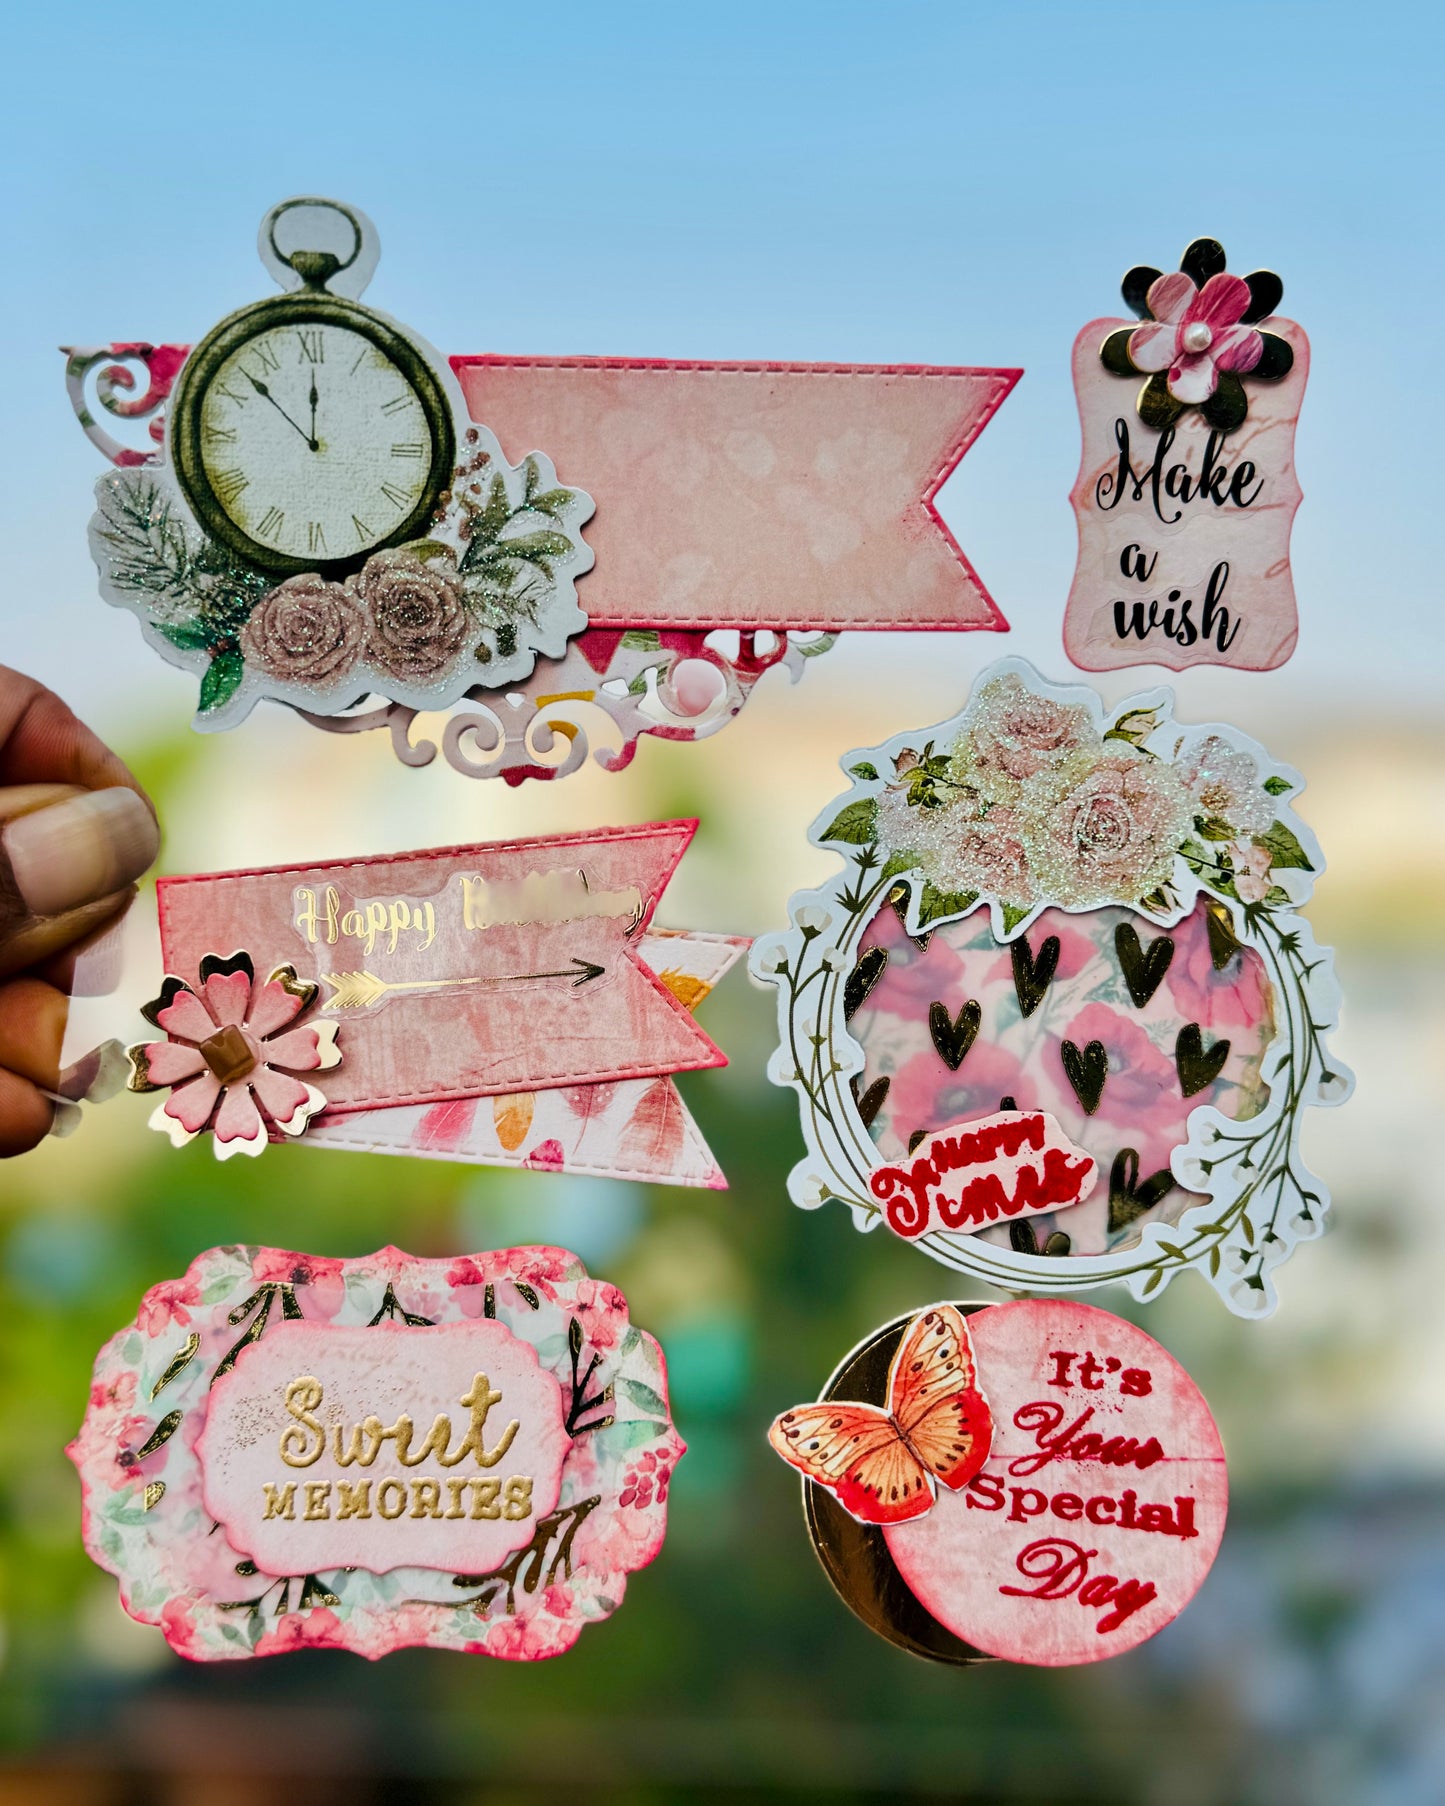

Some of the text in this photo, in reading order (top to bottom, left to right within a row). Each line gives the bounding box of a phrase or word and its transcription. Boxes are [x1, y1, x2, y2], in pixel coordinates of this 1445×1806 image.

[1096, 418, 1264, 524] Make
[1120, 544, 1158, 582] a
[1113, 561, 1241, 652] wish
[296, 886, 438, 956] Happy
[1047, 1351, 1152, 1397] It's
[262, 1475, 534, 1521] MEMORIES
[966, 1473, 1199, 1537] Special
[999, 1538, 1158, 1634] Day
